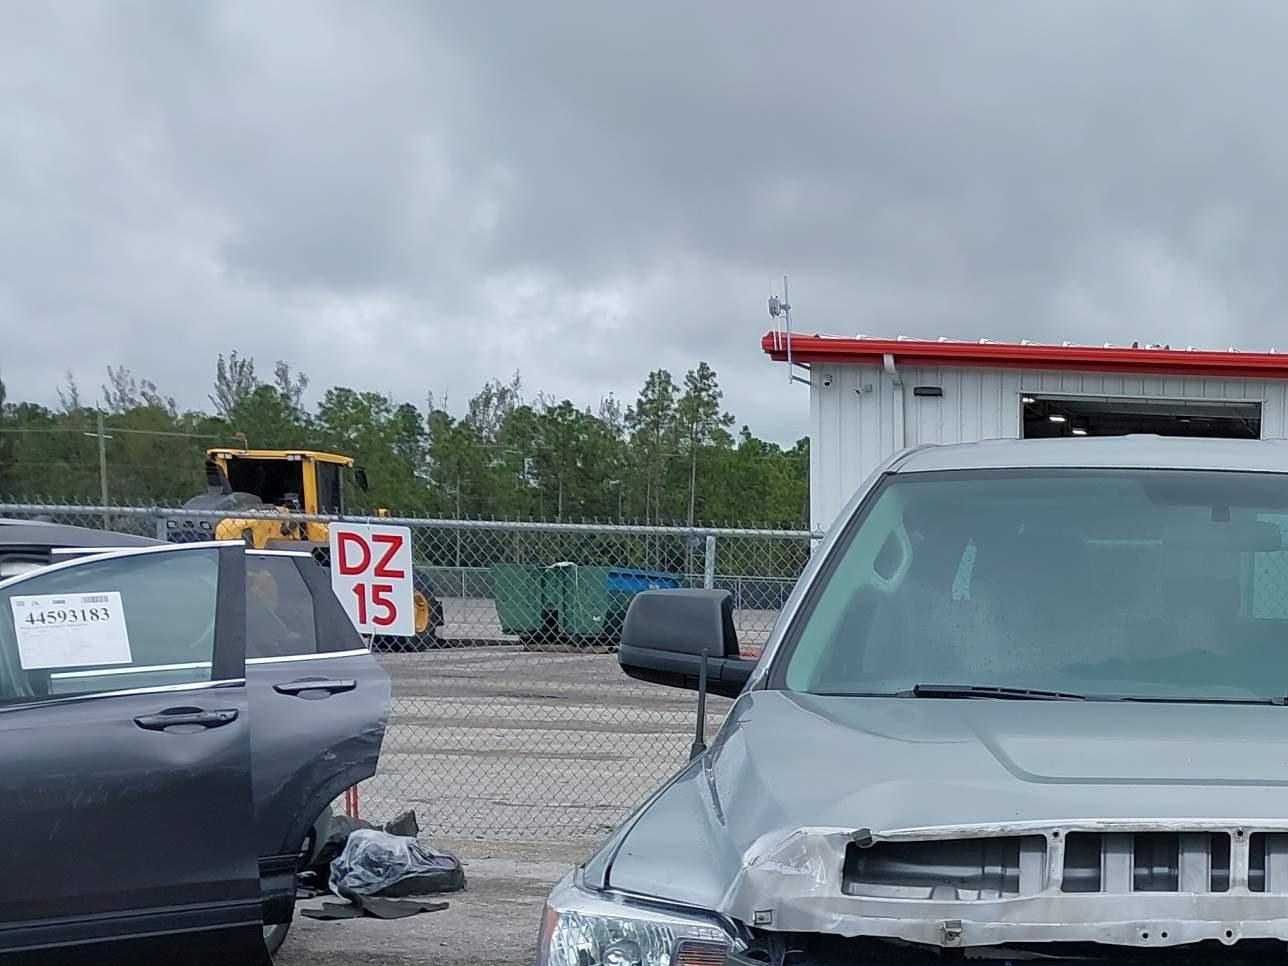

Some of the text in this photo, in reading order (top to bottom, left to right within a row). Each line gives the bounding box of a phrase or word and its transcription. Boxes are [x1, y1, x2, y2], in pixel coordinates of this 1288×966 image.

[337, 531, 404, 579] DZ
[25, 607, 110, 625] 44593183
[352, 583, 397, 626] 15
